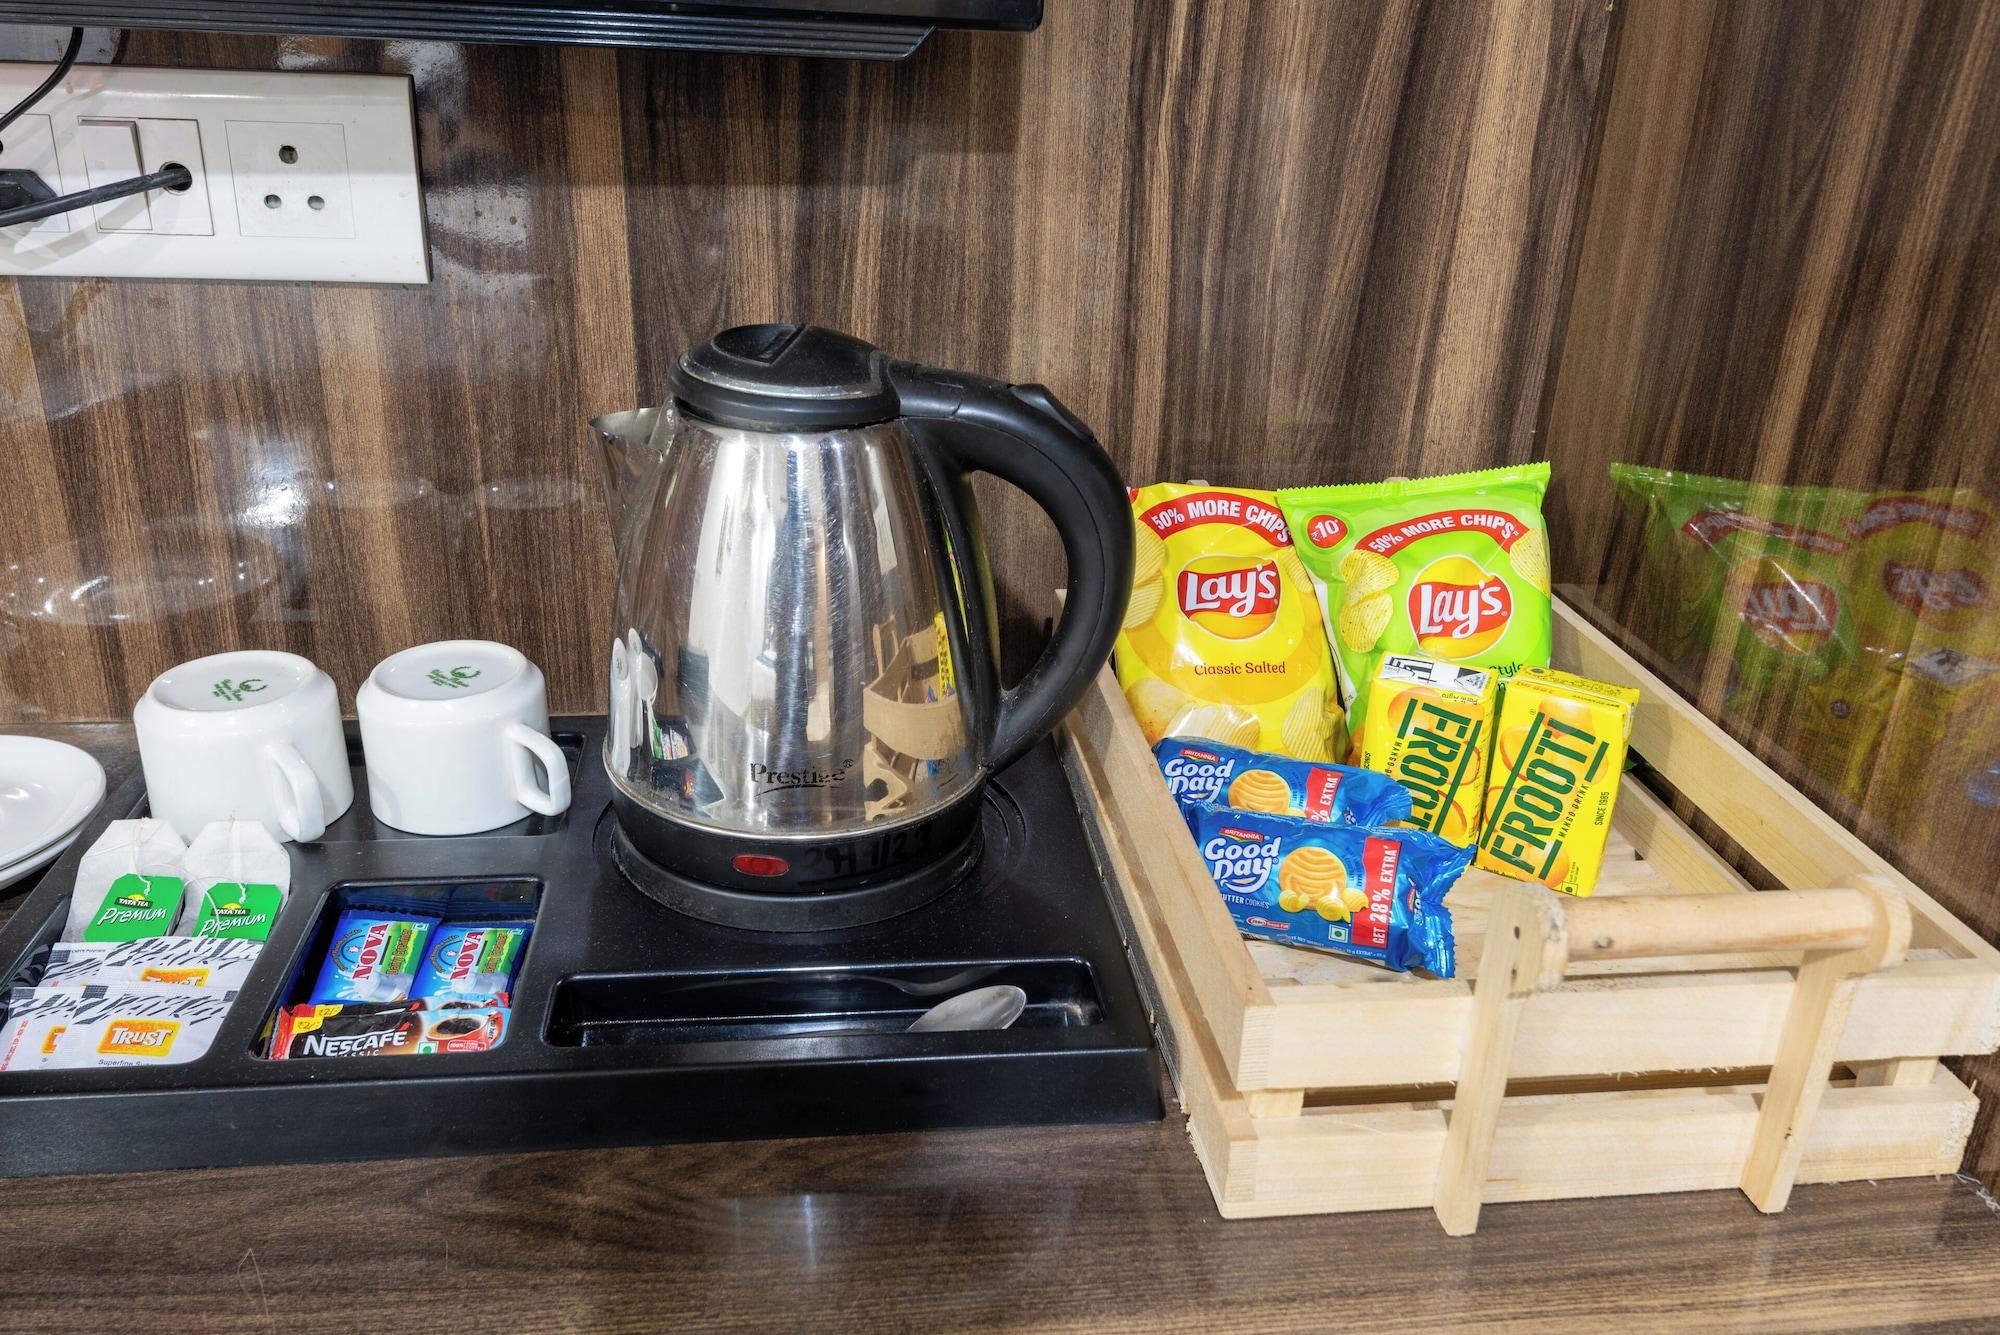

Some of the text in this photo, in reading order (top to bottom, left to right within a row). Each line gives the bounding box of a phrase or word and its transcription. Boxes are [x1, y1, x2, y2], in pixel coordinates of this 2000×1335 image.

[1151, 507, 1185, 530] 50%
[1187, 499, 1242, 519] MORE
[1368, 532, 1404, 554] 50%
[1399, 515, 1457, 538] MORE
[1185, 563, 1277, 617] Lay's
[1419, 580, 1503, 639] Lay's
[1194, 661, 1286, 676] Classic Salted
[1164, 758, 1236, 778] Good
[1184, 749, 1216, 762] BRITANNIA
[1396, 702, 1473, 832] FROOT
[1171, 775, 1225, 804] Day
[1489, 717, 1597, 875] FROOTI
[1594, 791, 1610, 826] SINCE 1985
[1204, 836, 1281, 861] Good
[1224, 829, 1260, 841] BRITANNIA
[1213, 857, 1273, 894] Day
[119, 898, 137, 906] TATA
[1220, 893, 1244, 905] UTTER
[1369, 888, 1392, 924] 28%
[1372, 926, 1387, 945] GET
[351, 923, 389, 981] NOVA
[449, 930, 485, 980] NOVA
[110, 1027, 174, 1047] TRUST
